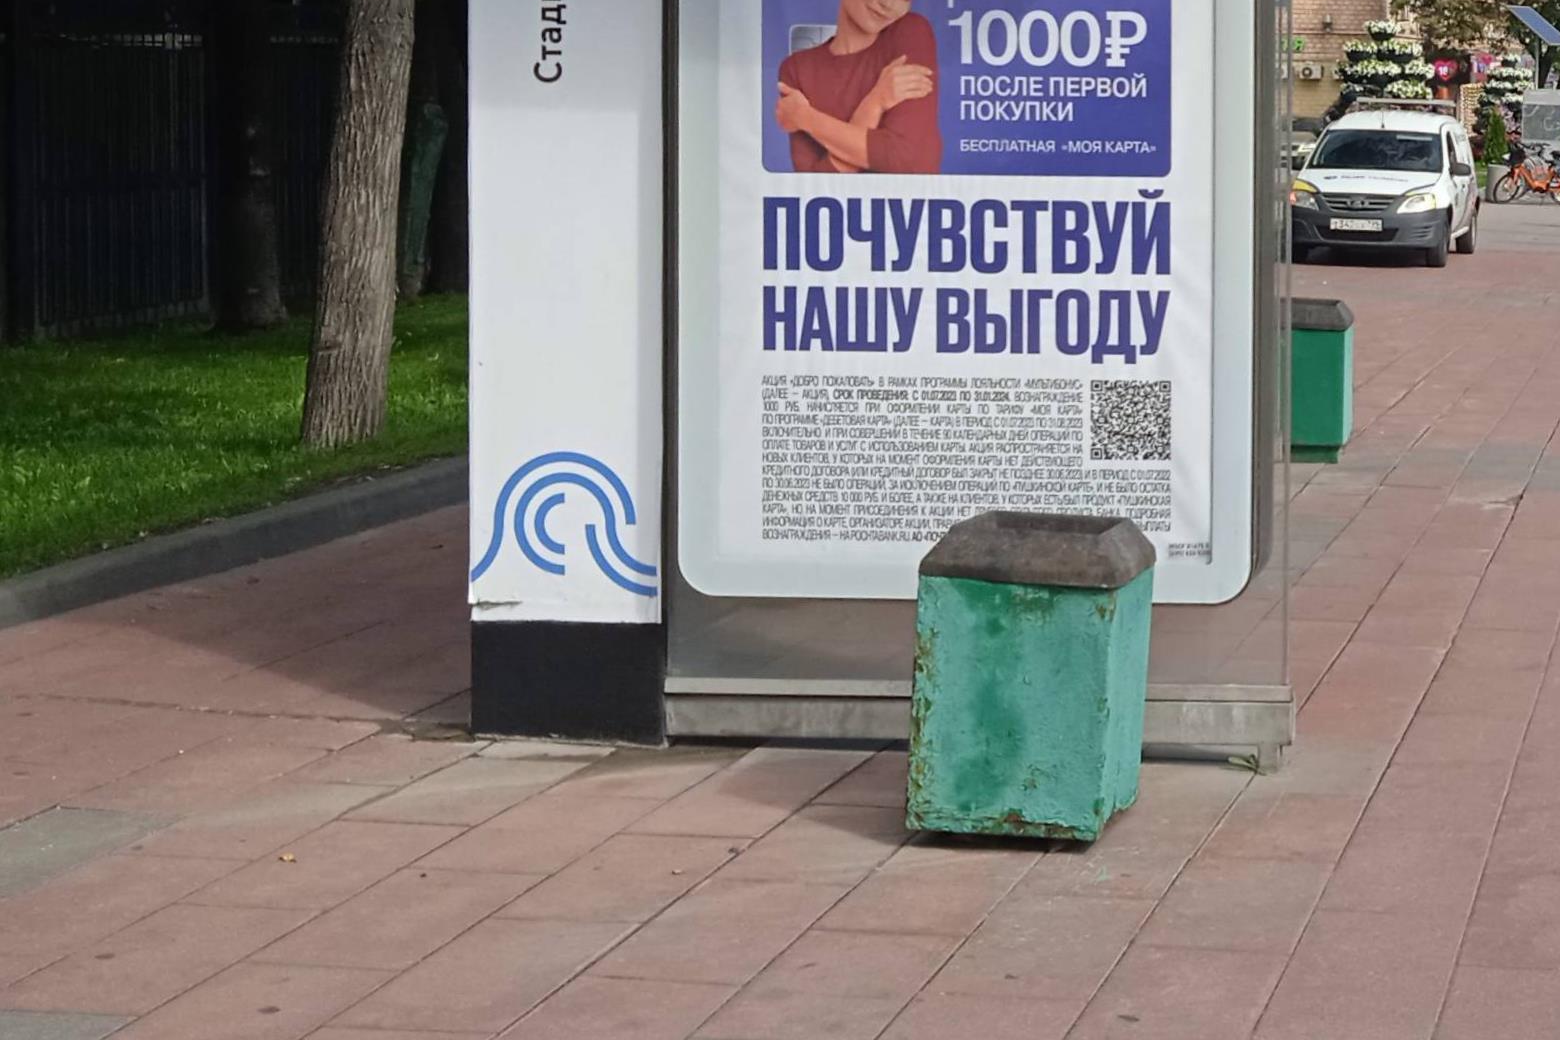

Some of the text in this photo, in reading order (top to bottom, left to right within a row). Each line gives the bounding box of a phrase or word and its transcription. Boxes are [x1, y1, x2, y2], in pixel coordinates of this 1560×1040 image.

[960, 73, 1148, 98] ПОСЛЕ ПЕРВОЙ
[960, 100, 1074, 122] ПОКУПКИ
[959, 138, 1157, 154] БЕСПЛАТНАЯ «МОЯ КАРТА»
[762, 189, 1172, 275] ПОЧУВСТВУЙ
[762, 285, 1171, 365] НАШУ ВЫГОДУ
